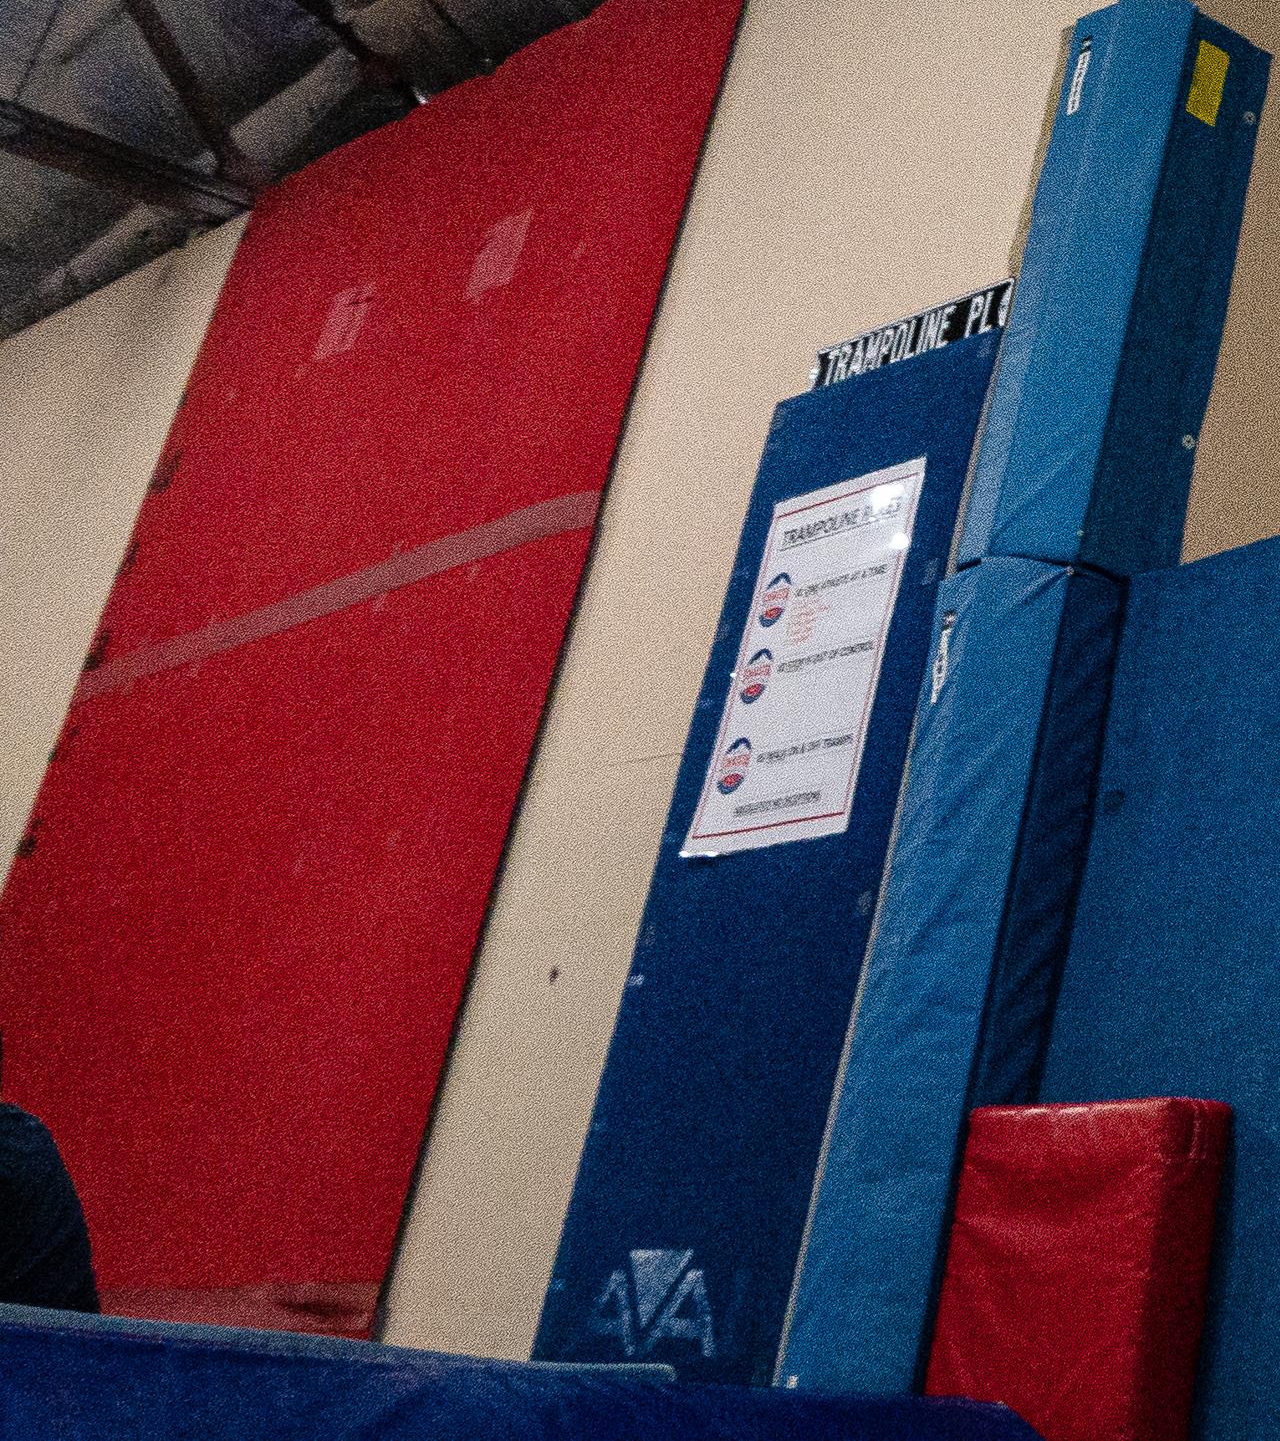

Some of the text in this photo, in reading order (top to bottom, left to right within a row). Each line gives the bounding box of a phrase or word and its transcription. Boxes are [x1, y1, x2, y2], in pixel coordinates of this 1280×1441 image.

[823, 289, 996, 386] TRAMPOLINE PL
[780, 507, 860, 548] TRAMPOLINE
